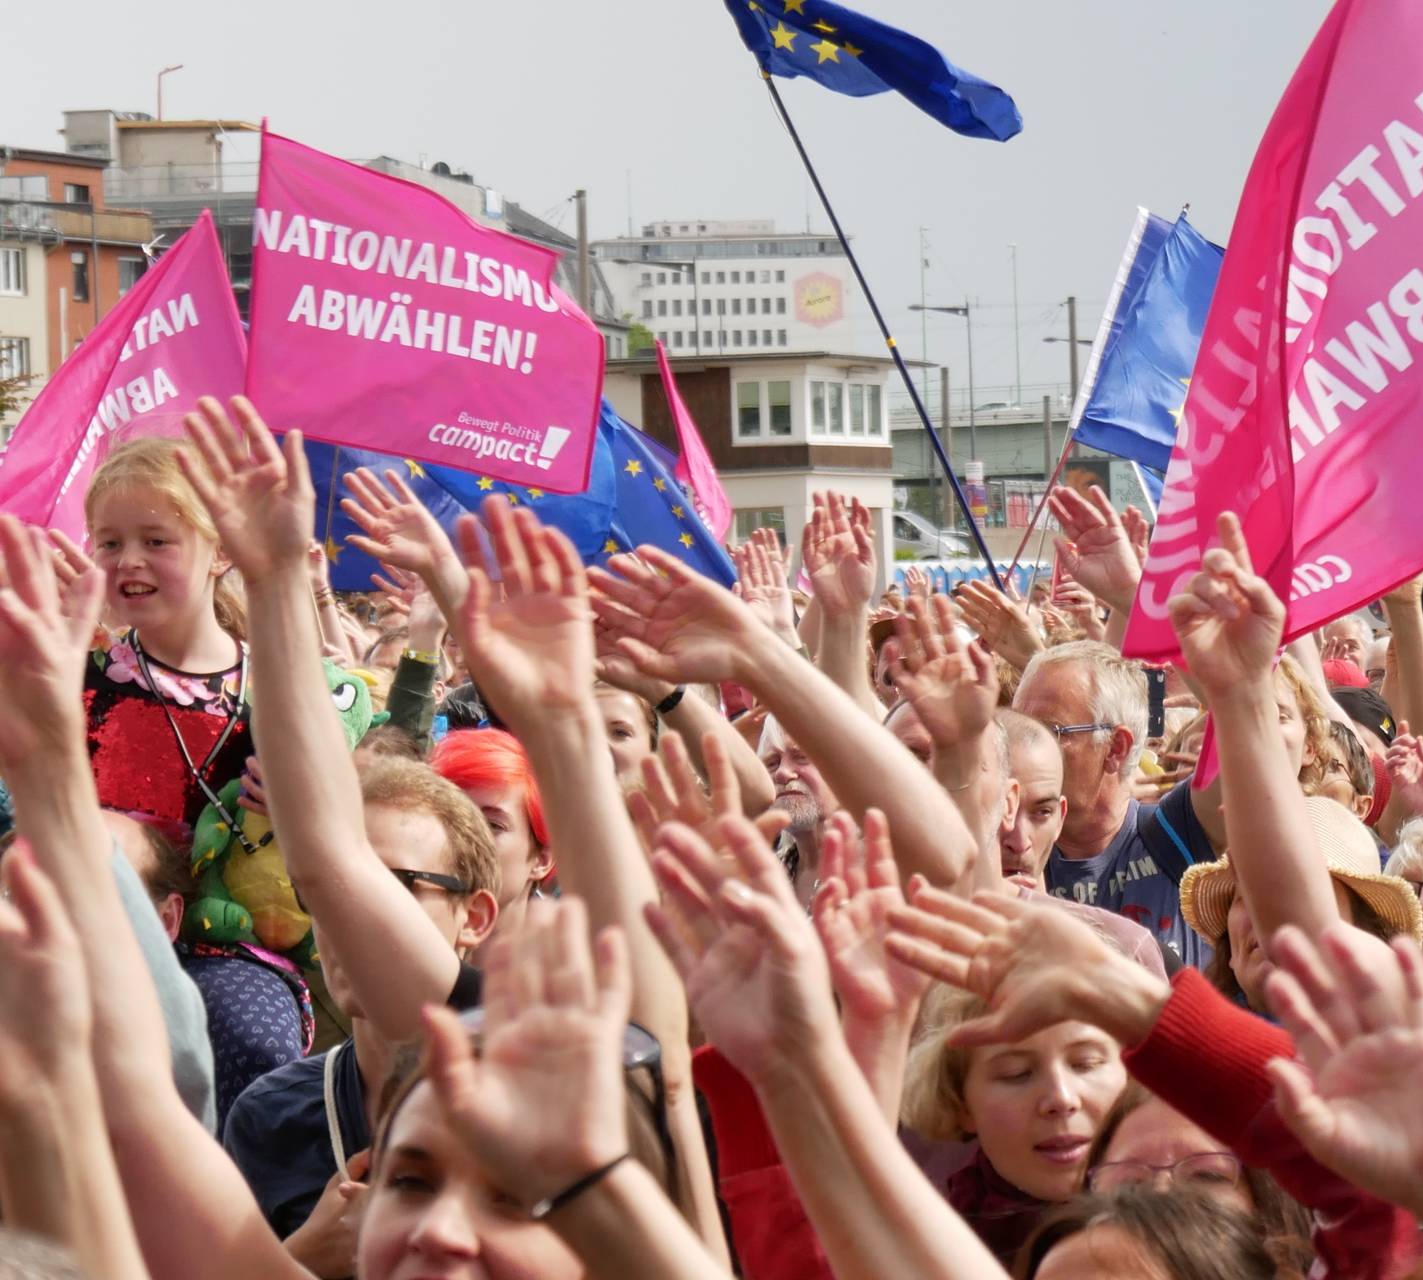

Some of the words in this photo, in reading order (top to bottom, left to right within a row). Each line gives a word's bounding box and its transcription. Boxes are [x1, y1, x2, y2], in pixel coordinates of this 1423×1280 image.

[253, 207, 568, 317] NATIONALISMU
[287, 284, 537, 375] ABWÄHLEN!
[428, 423, 571, 471] campact!
[457, 411, 499, 432] Bewegt
[501, 422, 542, 443] Politik
[1073, 881, 1098, 905] OF
